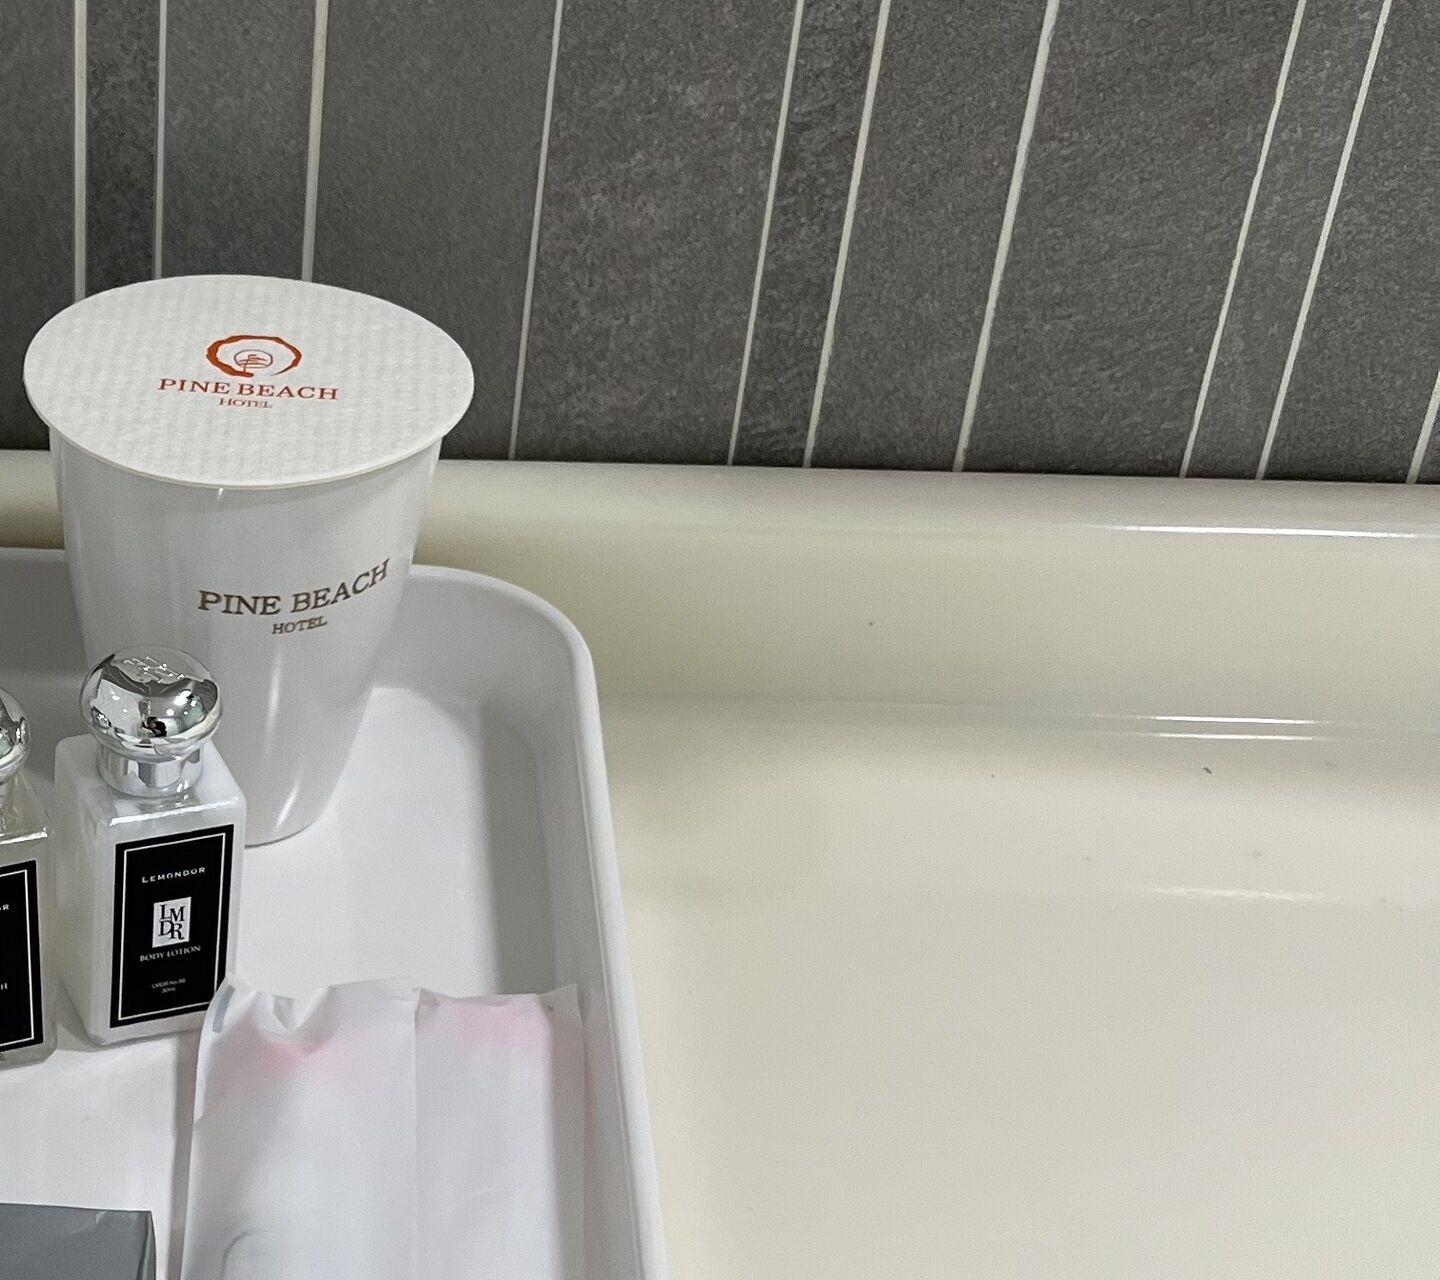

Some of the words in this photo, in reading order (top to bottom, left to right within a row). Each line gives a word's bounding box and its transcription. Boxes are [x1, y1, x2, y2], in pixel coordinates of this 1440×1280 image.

[159, 378, 230, 394] PINE
[238, 383, 339, 400] BEACH
[219, 398, 272, 408] HOTEL
[198, 590, 281, 616] PINE
[290, 558, 390, 613] BEACH
[271, 616, 328, 635] HOTEL
